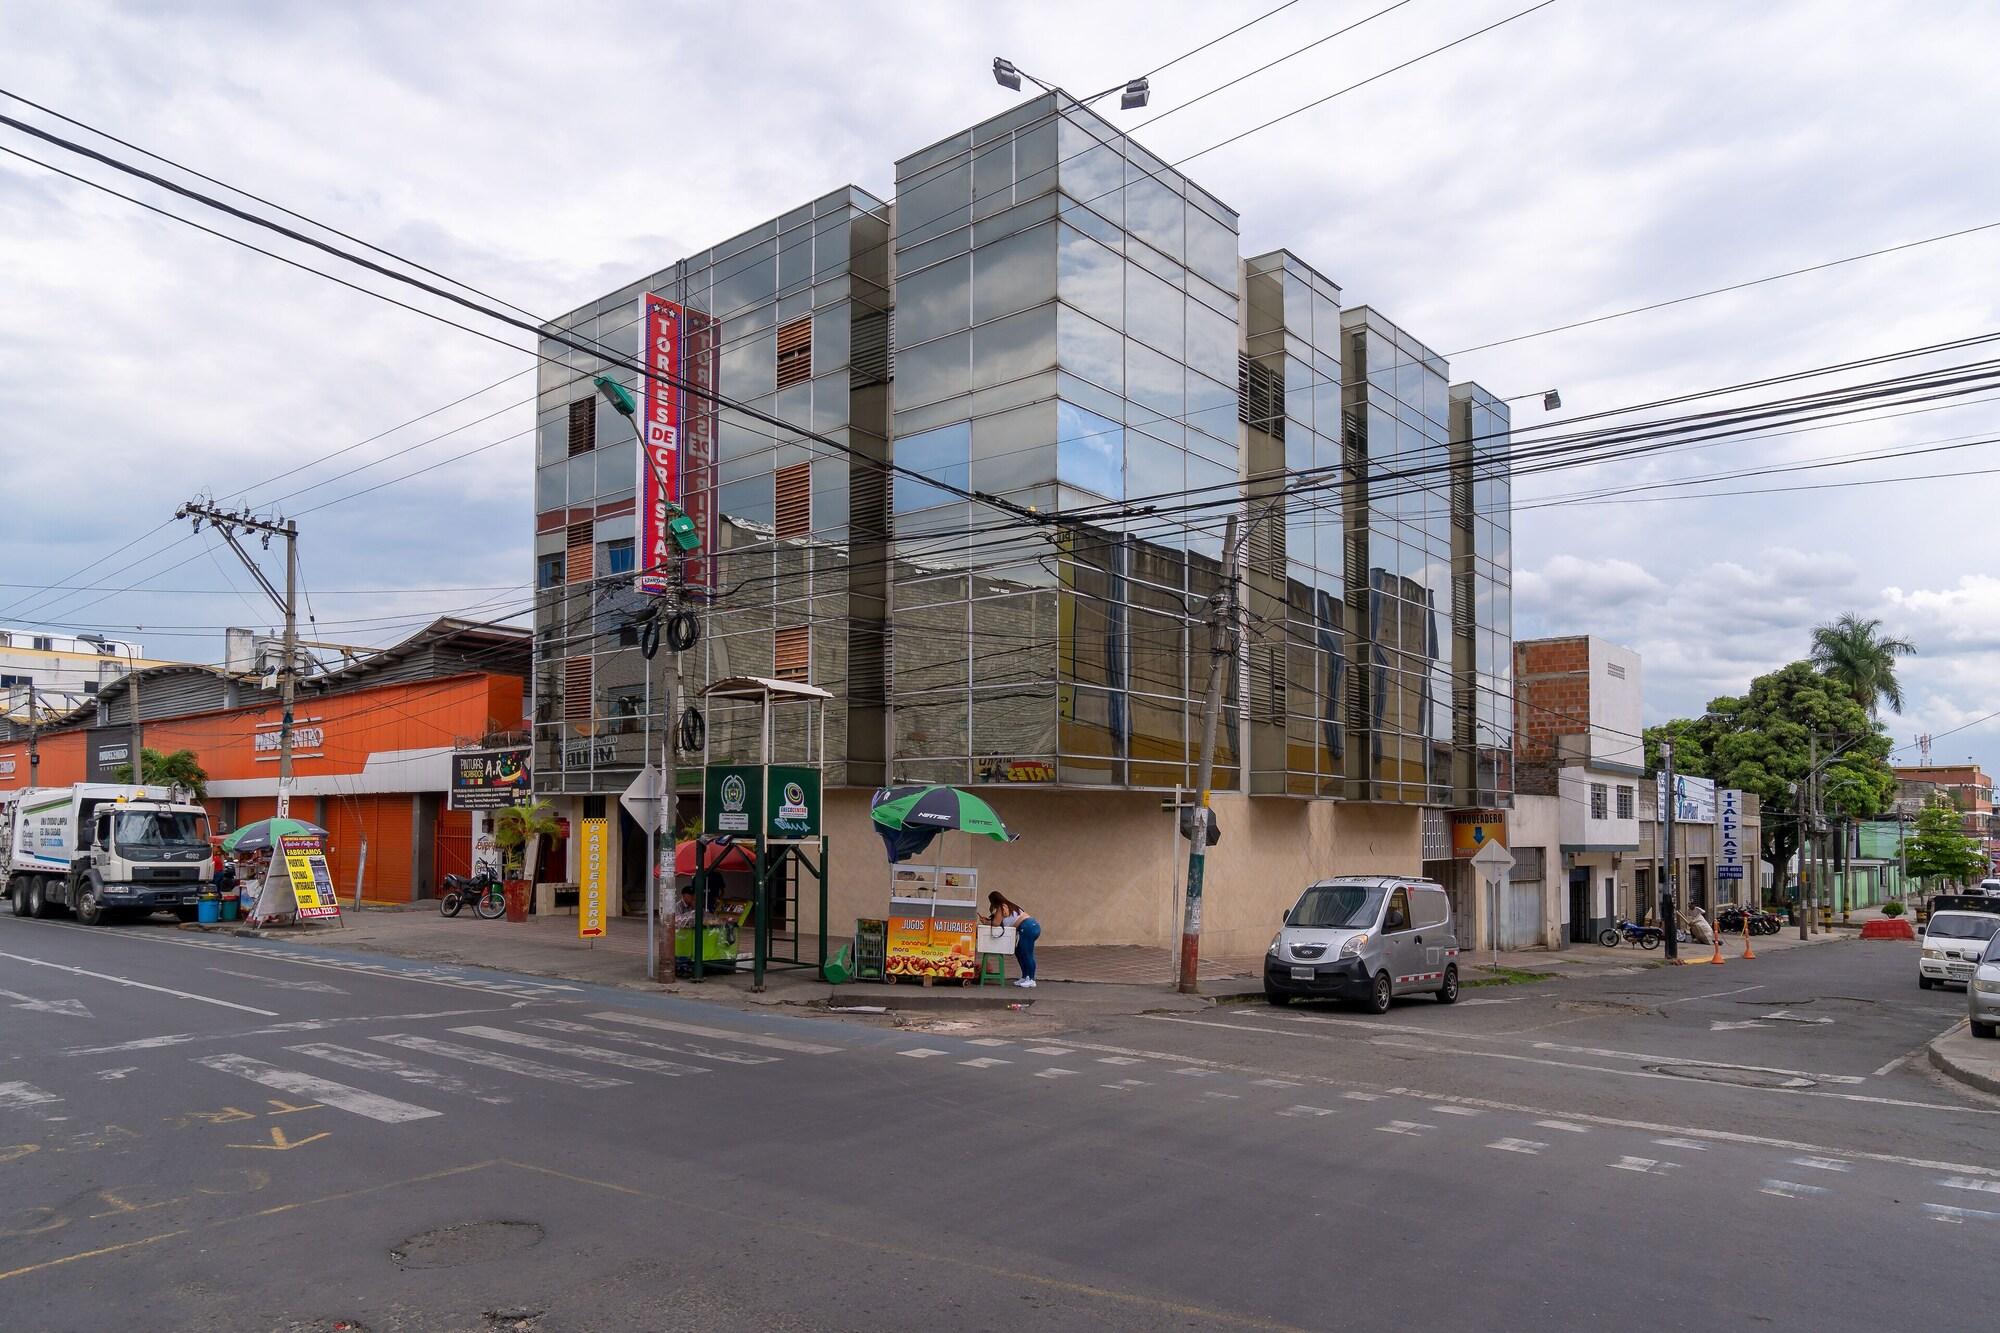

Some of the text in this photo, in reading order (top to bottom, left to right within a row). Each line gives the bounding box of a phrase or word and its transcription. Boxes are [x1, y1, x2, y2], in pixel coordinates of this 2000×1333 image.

[656, 318, 671, 424] TORRES
[651, 427, 674, 444] DE
[655, 448, 668, 573] CRISTAL
[460, 758, 484, 770] PINTURAS
[1455, 812, 1503, 825] PARQUEADERO
[1722, 793, 1738, 863] ITALPLAST
[588, 825, 600, 928] PARQUEADERO
[902, 920, 925, 930] JUGOS
[934, 921, 973, 934] NATURALES
